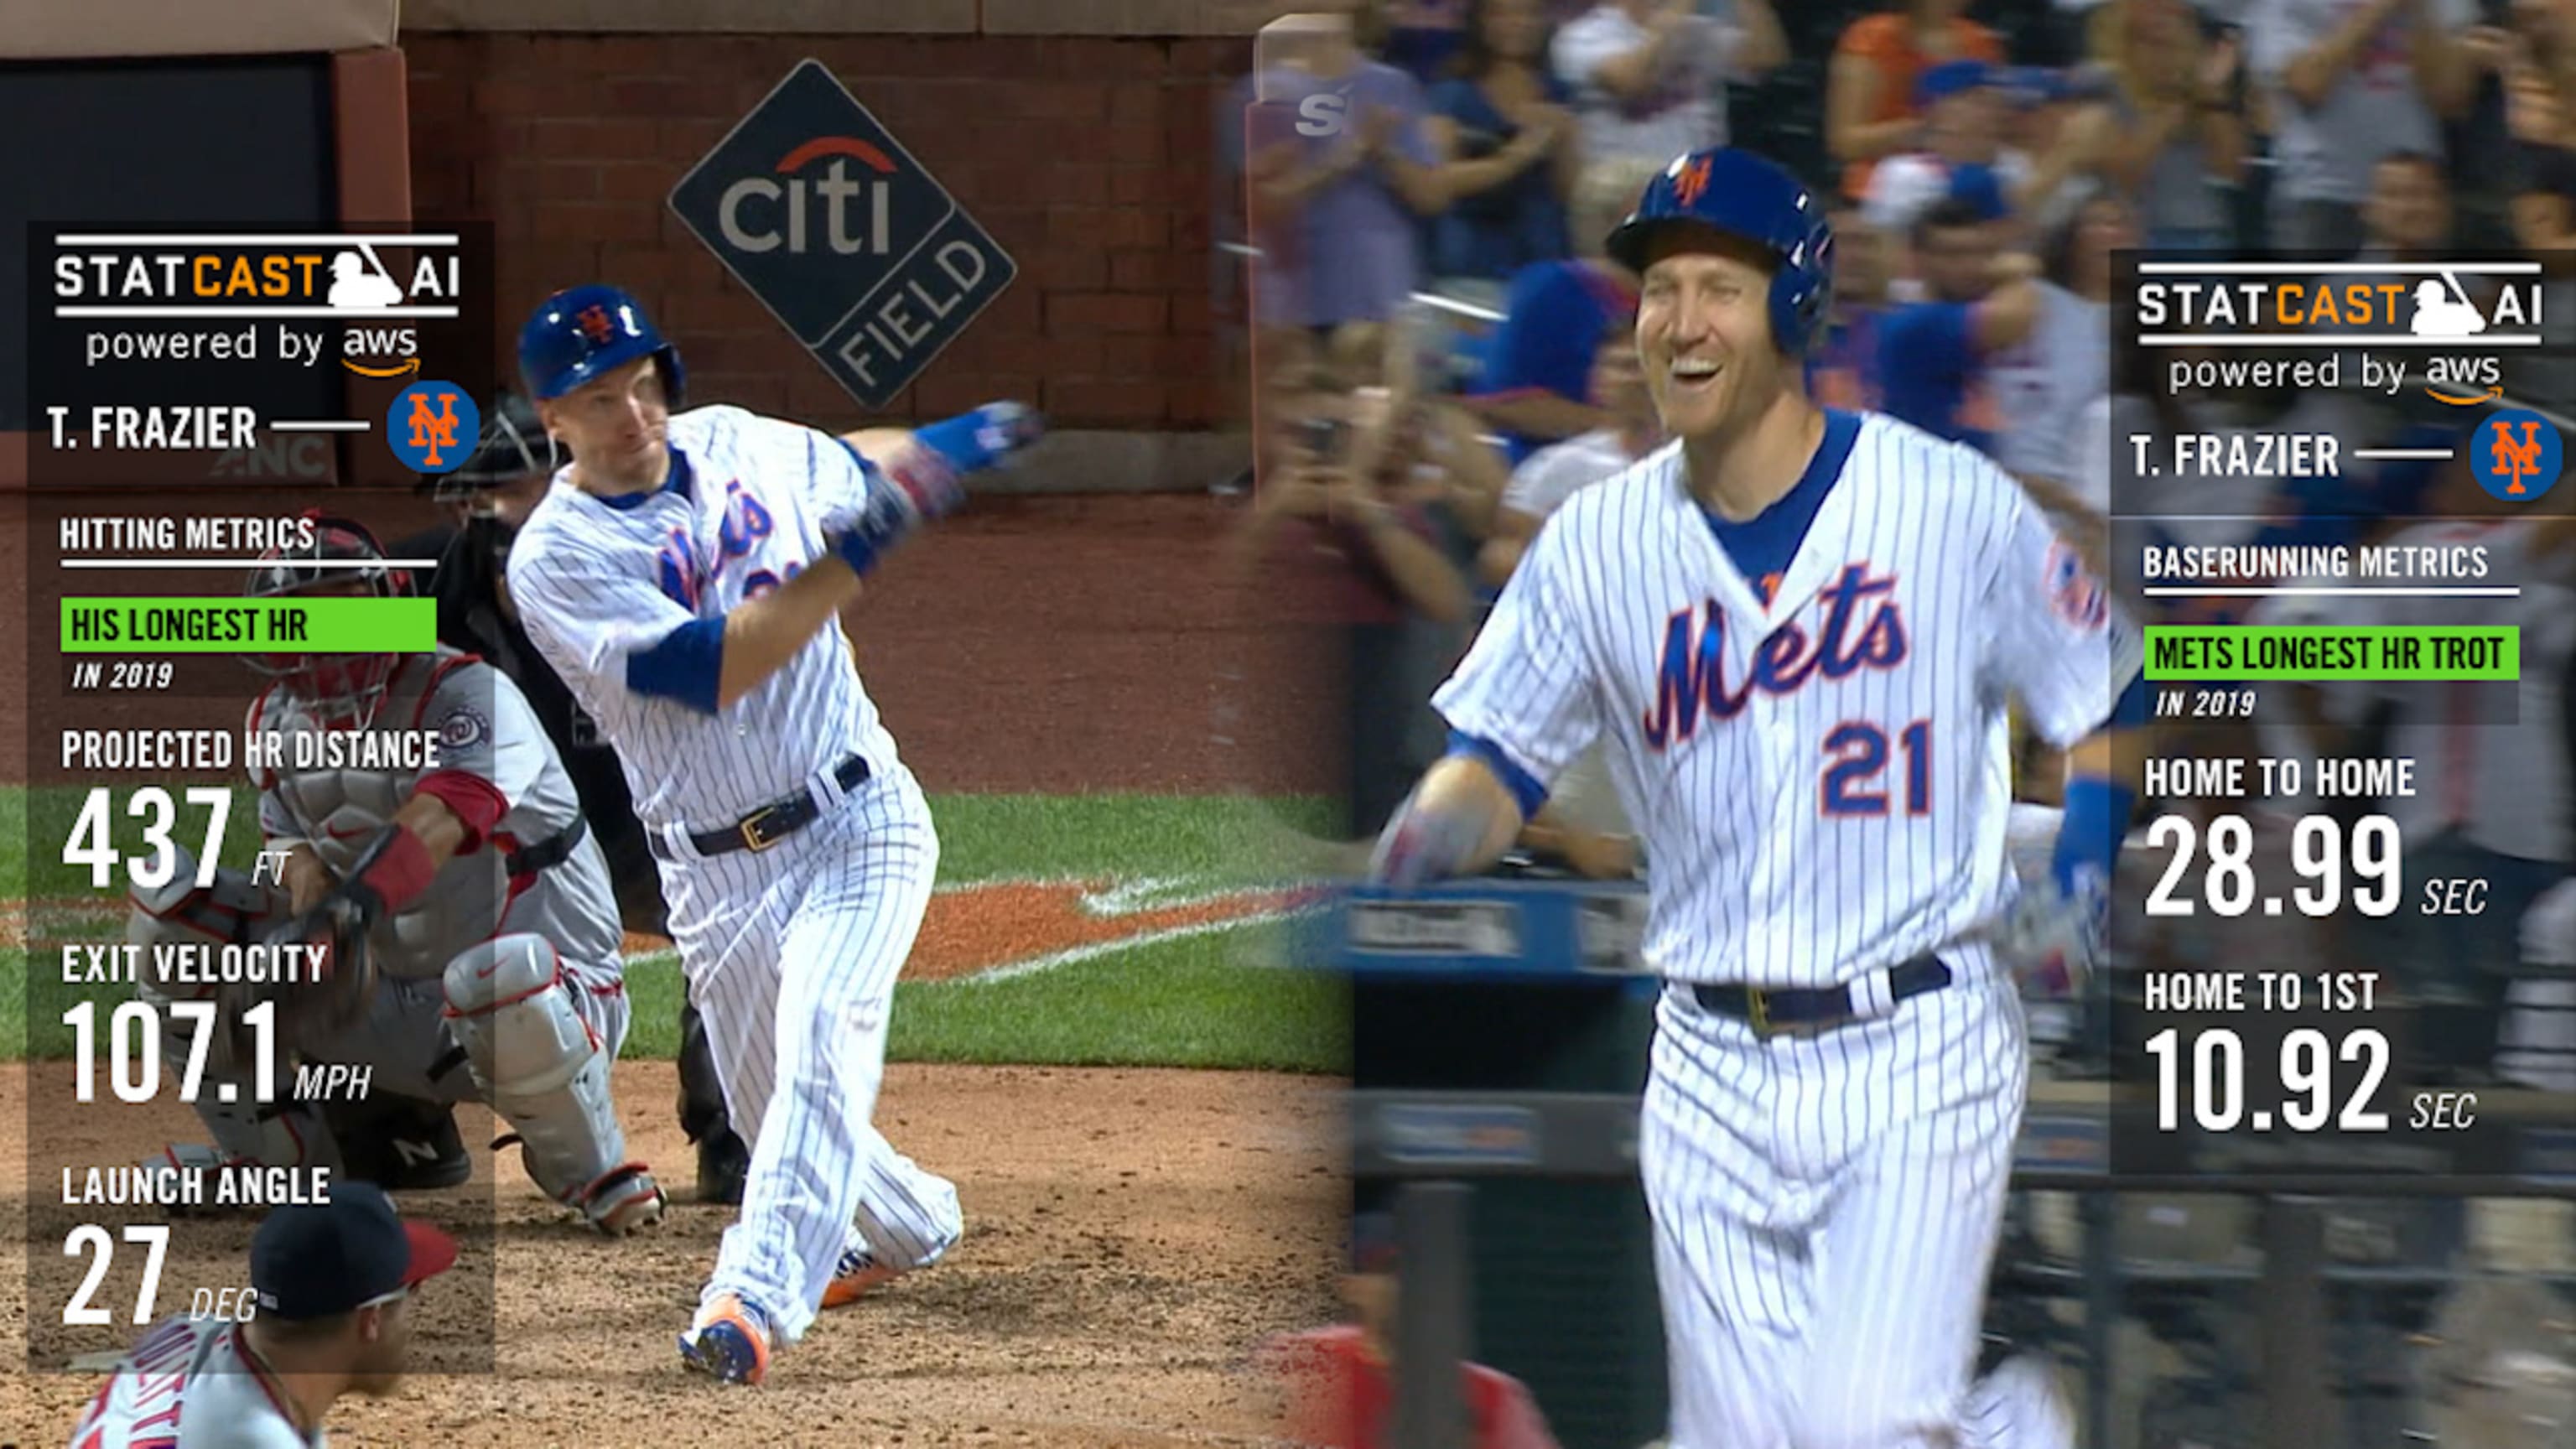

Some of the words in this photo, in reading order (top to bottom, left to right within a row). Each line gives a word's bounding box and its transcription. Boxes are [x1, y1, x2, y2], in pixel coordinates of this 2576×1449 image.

[719, 158, 890, 256] citi
[839, 240, 987, 387] FIELD
[1644, 560, 1908, 750] Mets
[1820, 719, 1933, 818] 21
